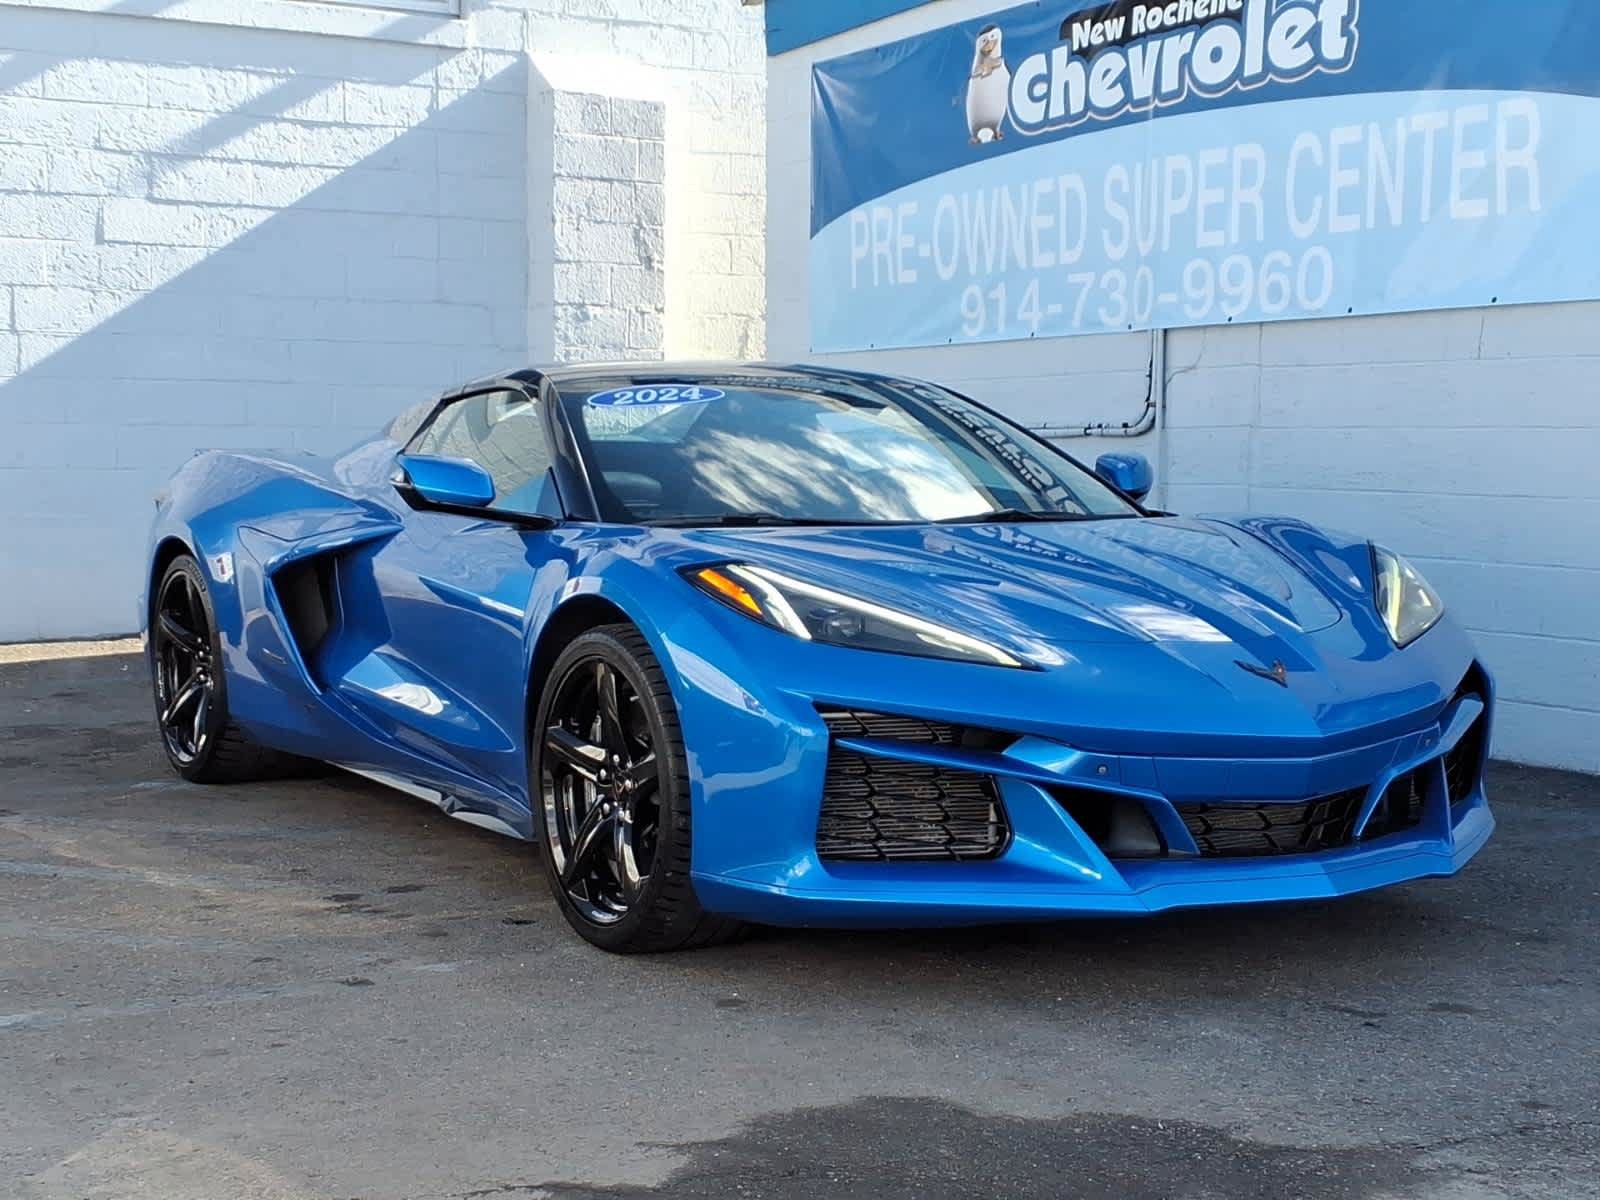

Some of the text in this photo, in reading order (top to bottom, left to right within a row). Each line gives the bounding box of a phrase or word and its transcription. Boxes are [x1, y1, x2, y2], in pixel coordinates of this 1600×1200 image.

[1012, 0, 1351, 124] Chevrolet
[1071, 16, 1126, 51] New
[850, 97, 1542, 289] PRE-OWNED SUPER CENTER
[961, 246, 1334, 336] 914-730-9960
[612, 386, 703, 405] 2024
